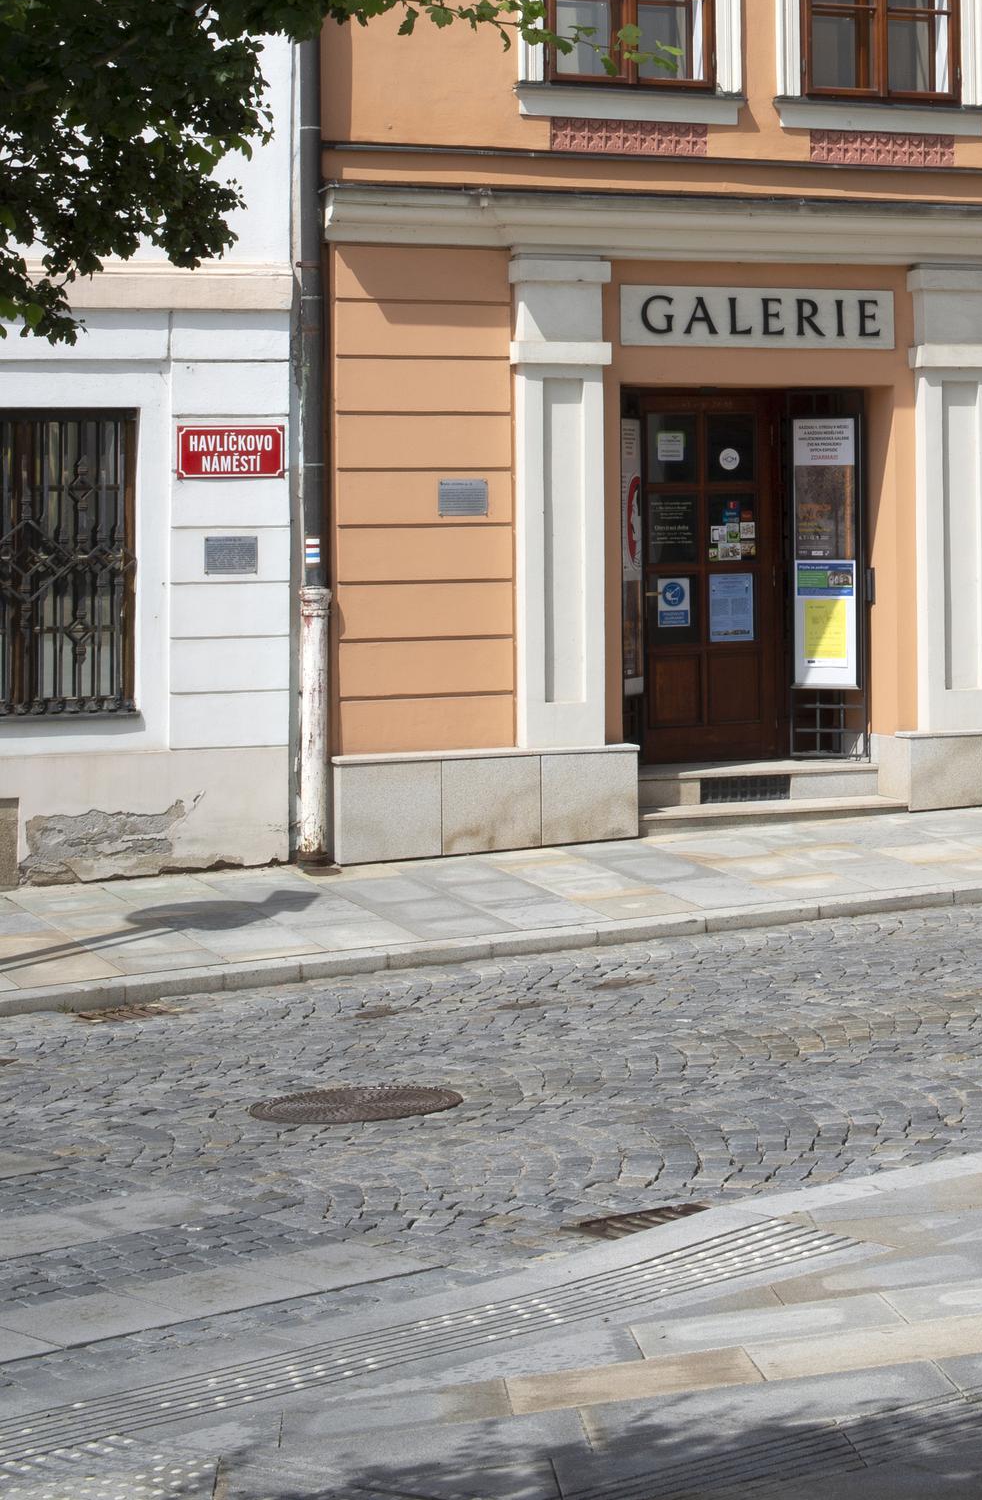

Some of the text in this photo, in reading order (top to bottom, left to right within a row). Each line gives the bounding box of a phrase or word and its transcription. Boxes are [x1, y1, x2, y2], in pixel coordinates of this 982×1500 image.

[640, 294, 881, 337] GALERIE
[189, 432, 273, 452] HAVLÍČKOVO
[201, 452, 262, 472] NÁMĚSTÍ
